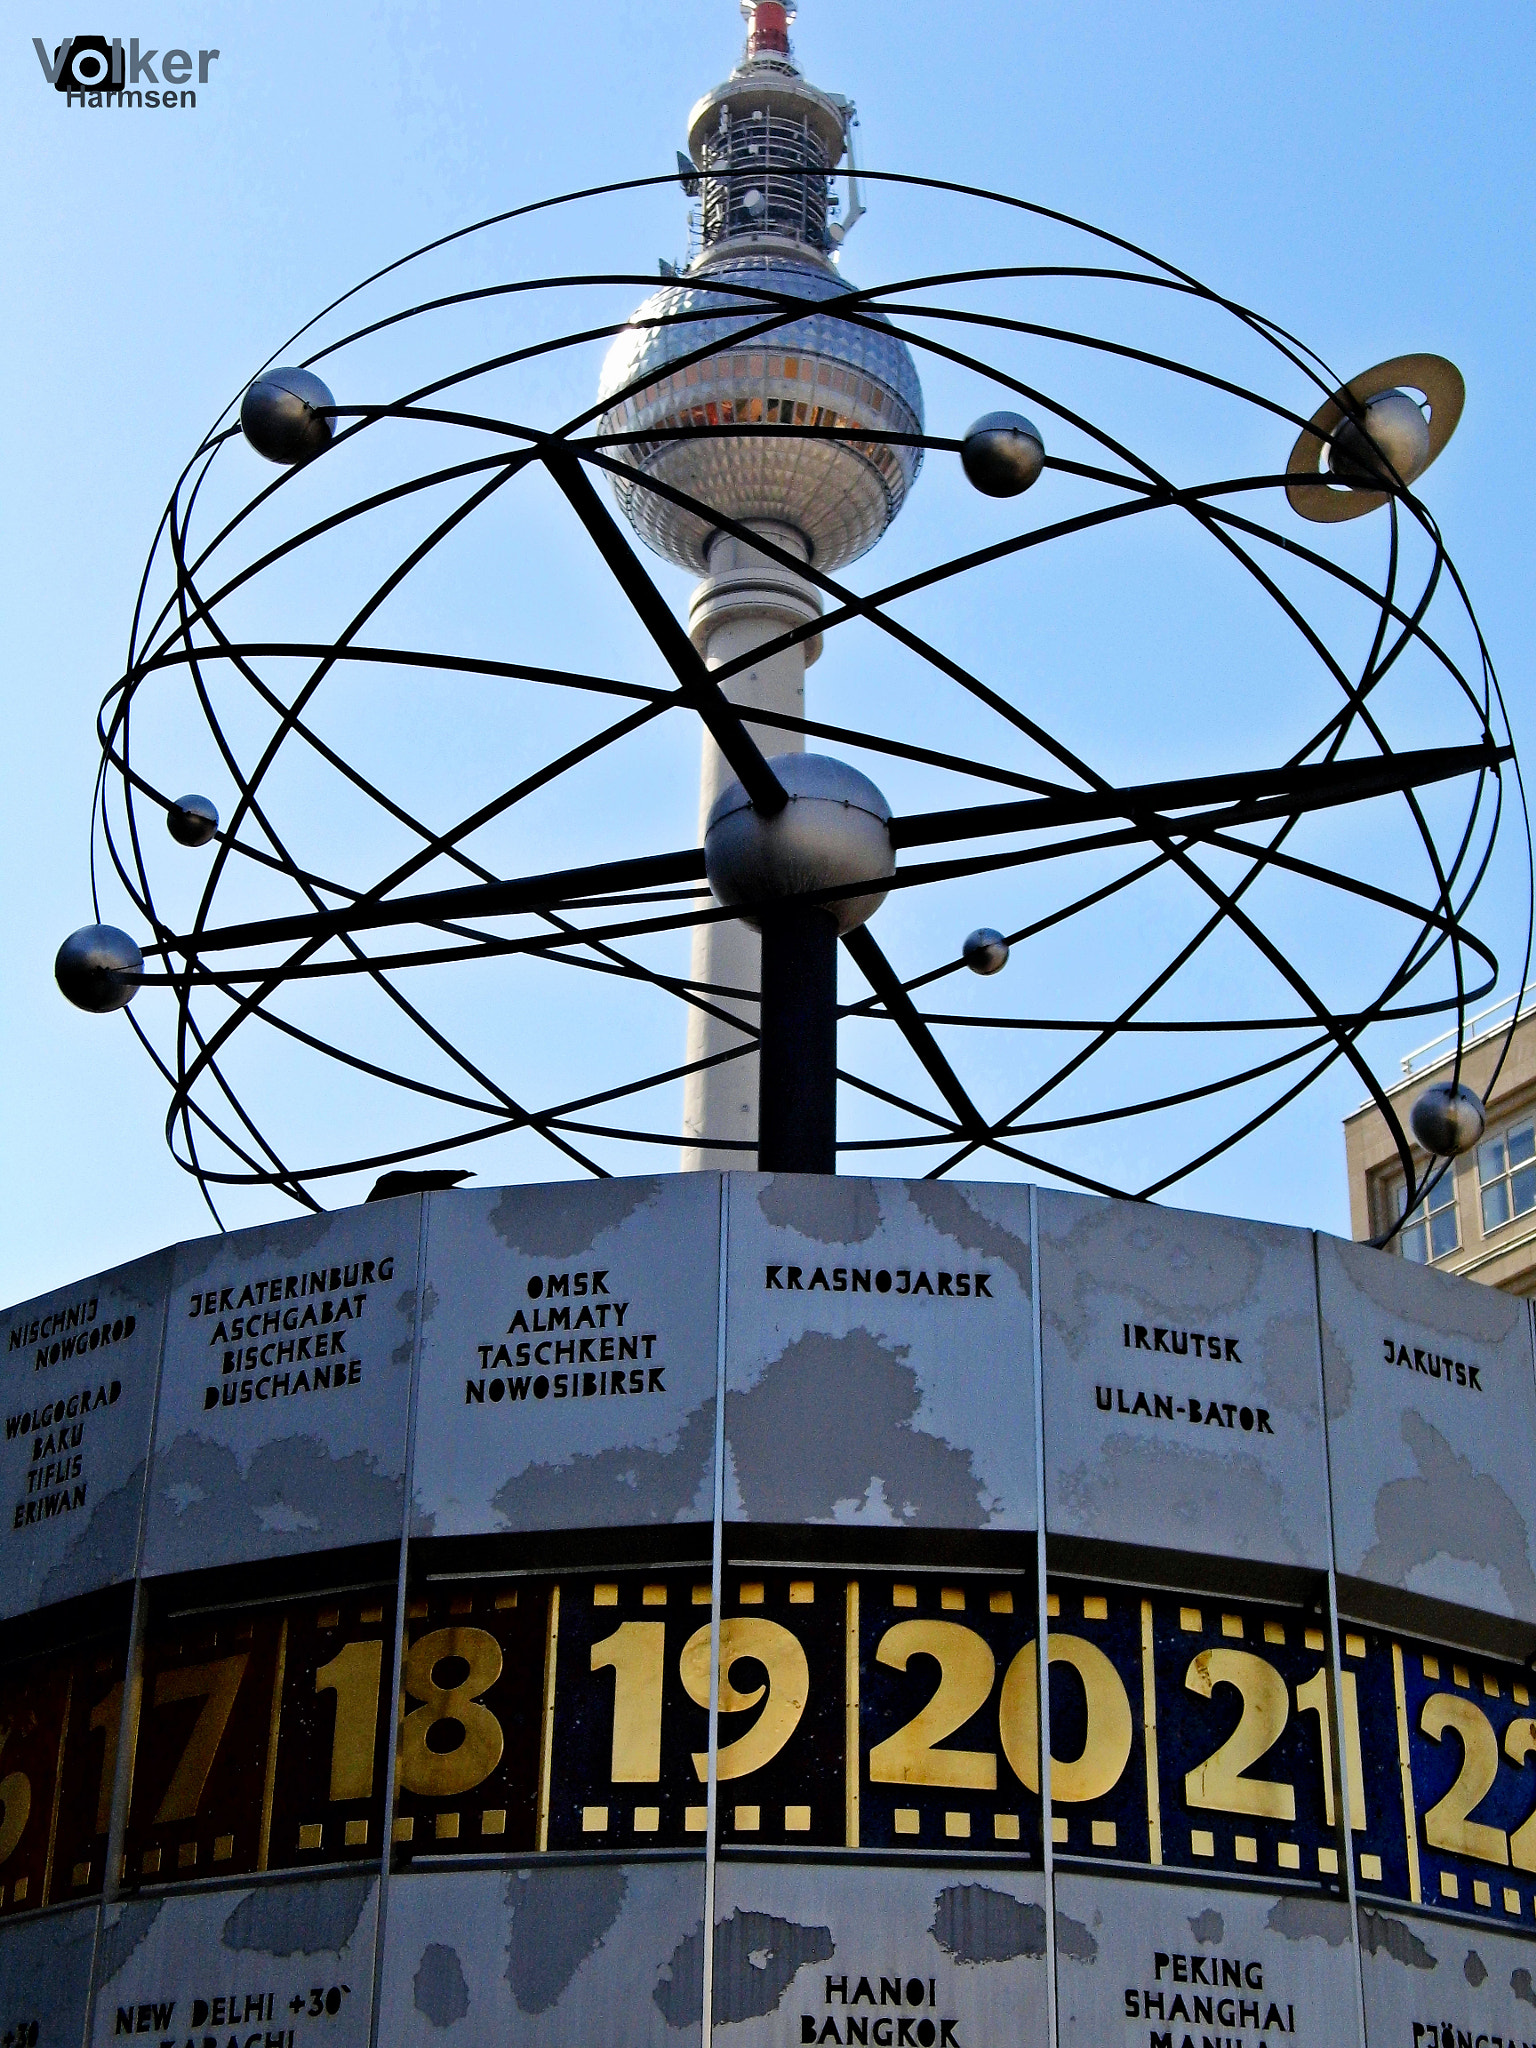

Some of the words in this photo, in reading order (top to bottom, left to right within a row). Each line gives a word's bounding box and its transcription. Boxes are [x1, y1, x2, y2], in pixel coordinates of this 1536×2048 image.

[189, 1257, 394, 1317] JEKATERINBURG
[527, 1270, 610, 1299] OMSK
[765, 1265, 994, 1298] KRASNOJARSK
[9, 1298, 99, 1351] NISCHNIJ
[210, 1294, 367, 1345] ASCHGABAT
[507, 1303, 629, 1334] ALMATY
[35, 1315, 136, 1371] NOWGOROD
[222, 1331, 347, 1374] BISCHKEK
[477, 1334, 657, 1369] TASCHKENT
[1122, 1323, 1243, 1363] IRKUTSK
[1383, 1339, 1483, 1391] JAKUTSK
[203, 1360, 362, 1410] DUSCHANBE
[465, 1368, 667, 1404] NOWOSIBIRSK
[6, 1381, 122, 1440] WOLGOGRAD
[1095, 1386, 1275, 1435] ULAN-BATOR
[32, 1423, 84, 1461] BAKU
[28, 1454, 82, 1493] TIFLIS
[14, 1484, 87, 1529] ERIWAN
[315, 1626, 505, 1802] 18
[590, 1617, 810, 1783] 19
[869, 1619, 1133, 1803] 20
[89, 1652, 251, 1835] 17
[1184, 1648, 1368, 1831] 21
[825, 1975, 936, 2007] HANOI
[1154, 1952, 1263, 1990] PEKING
[116, 2002, 176, 2035] NEW
[192, 1993, 275, 2027] DELHI
[801, 2014, 961, 2048] BANGKOK
[1125, 1989, 1295, 2033] SHANGHAI
